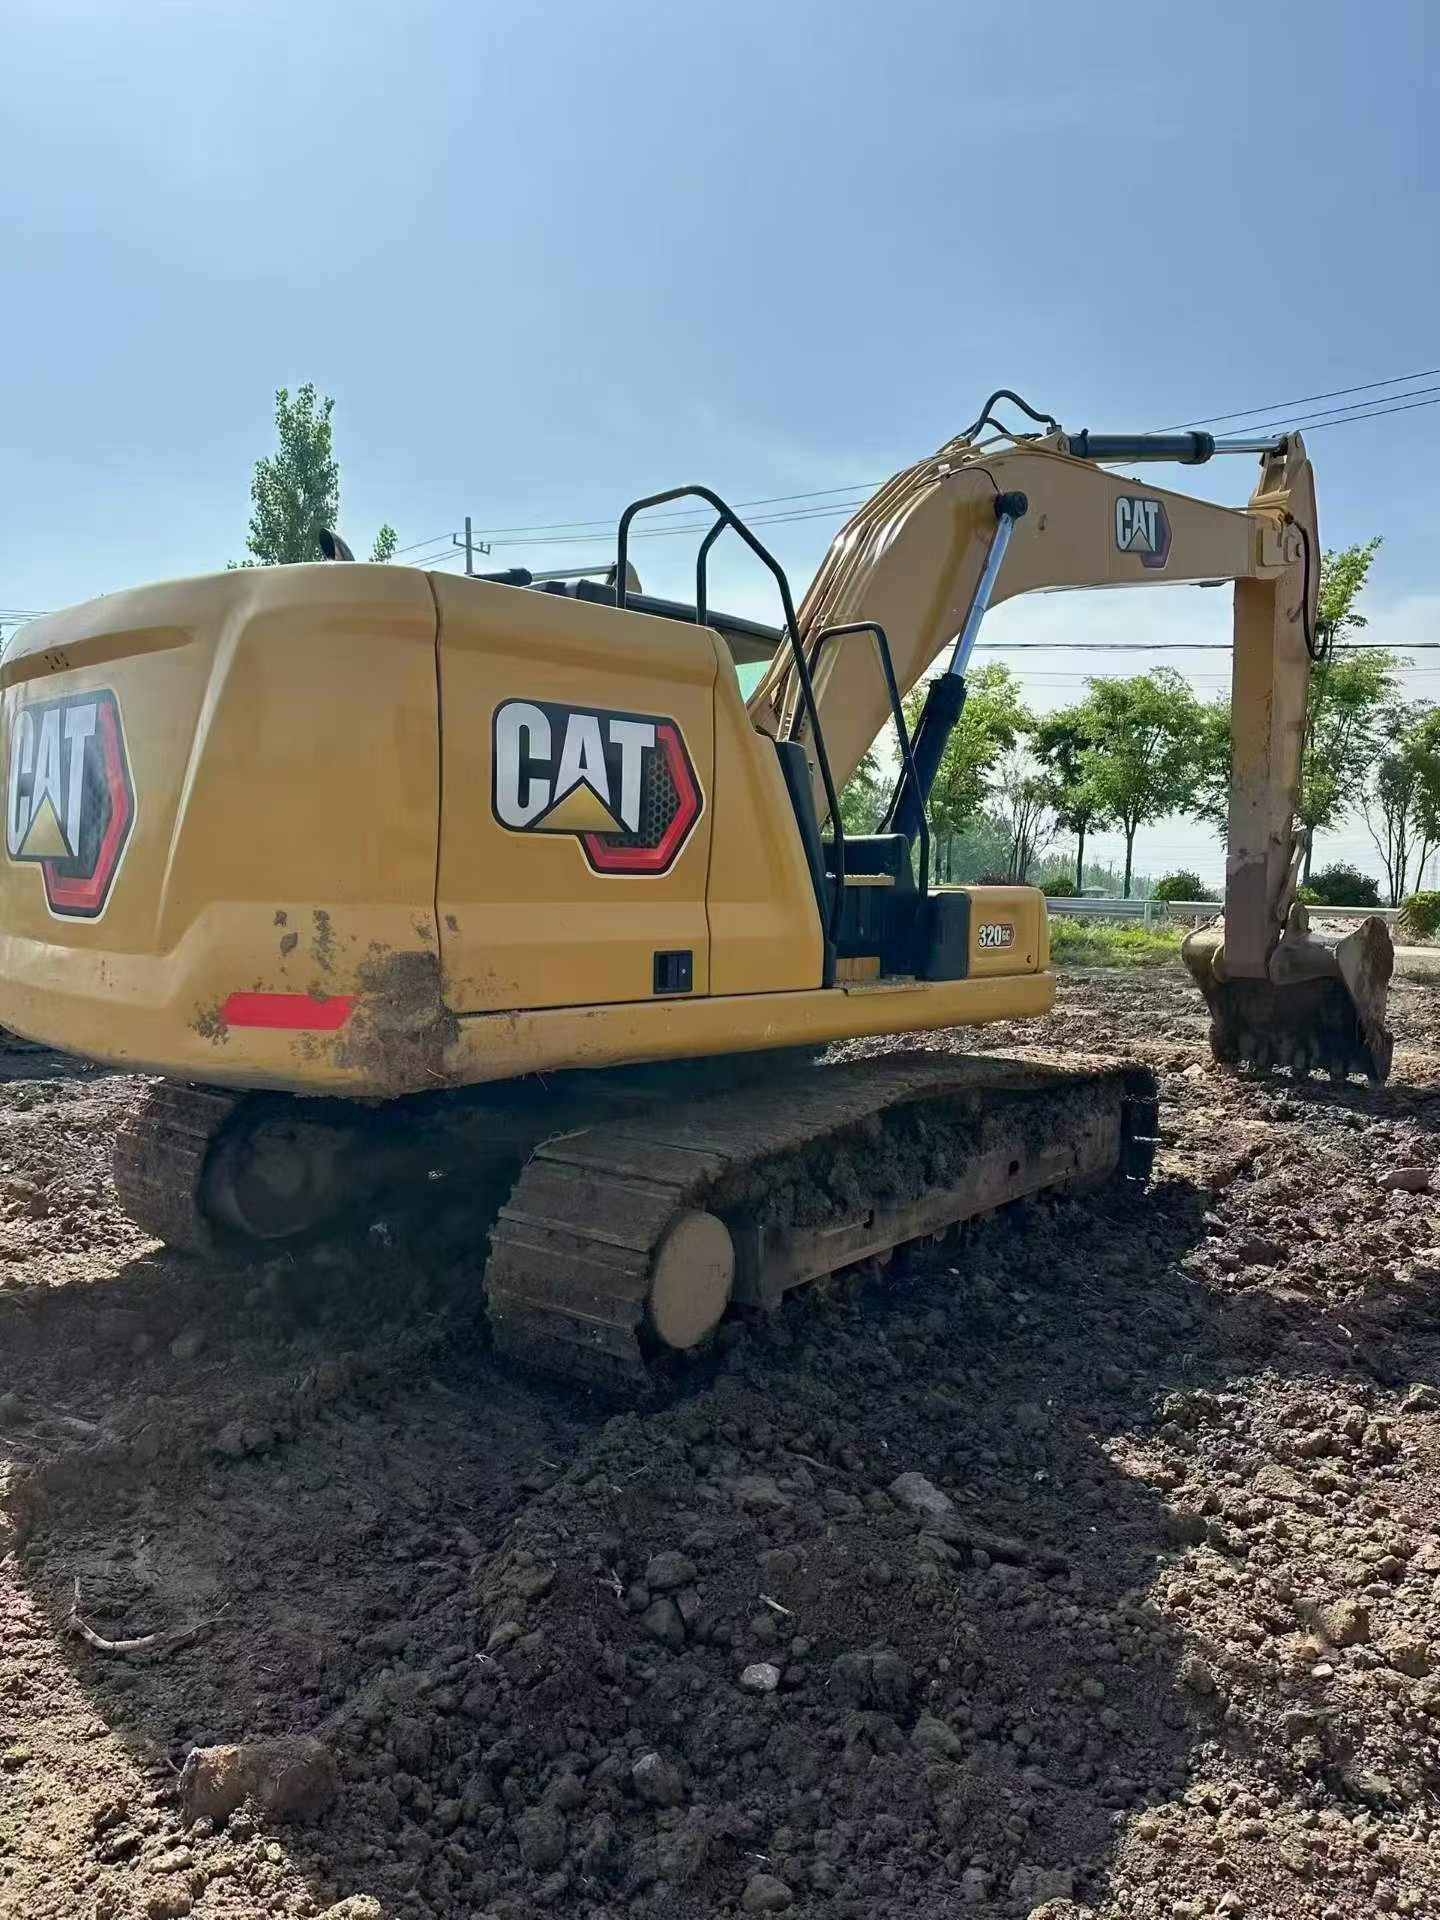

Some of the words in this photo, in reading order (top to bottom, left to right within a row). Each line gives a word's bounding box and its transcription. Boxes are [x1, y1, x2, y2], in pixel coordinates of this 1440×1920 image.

[1116, 497, 1158, 551] CAT
[8, 703, 97, 856] CAT
[496, 702, 656, 832] CAT
[979, 925, 1002, 947] 320
